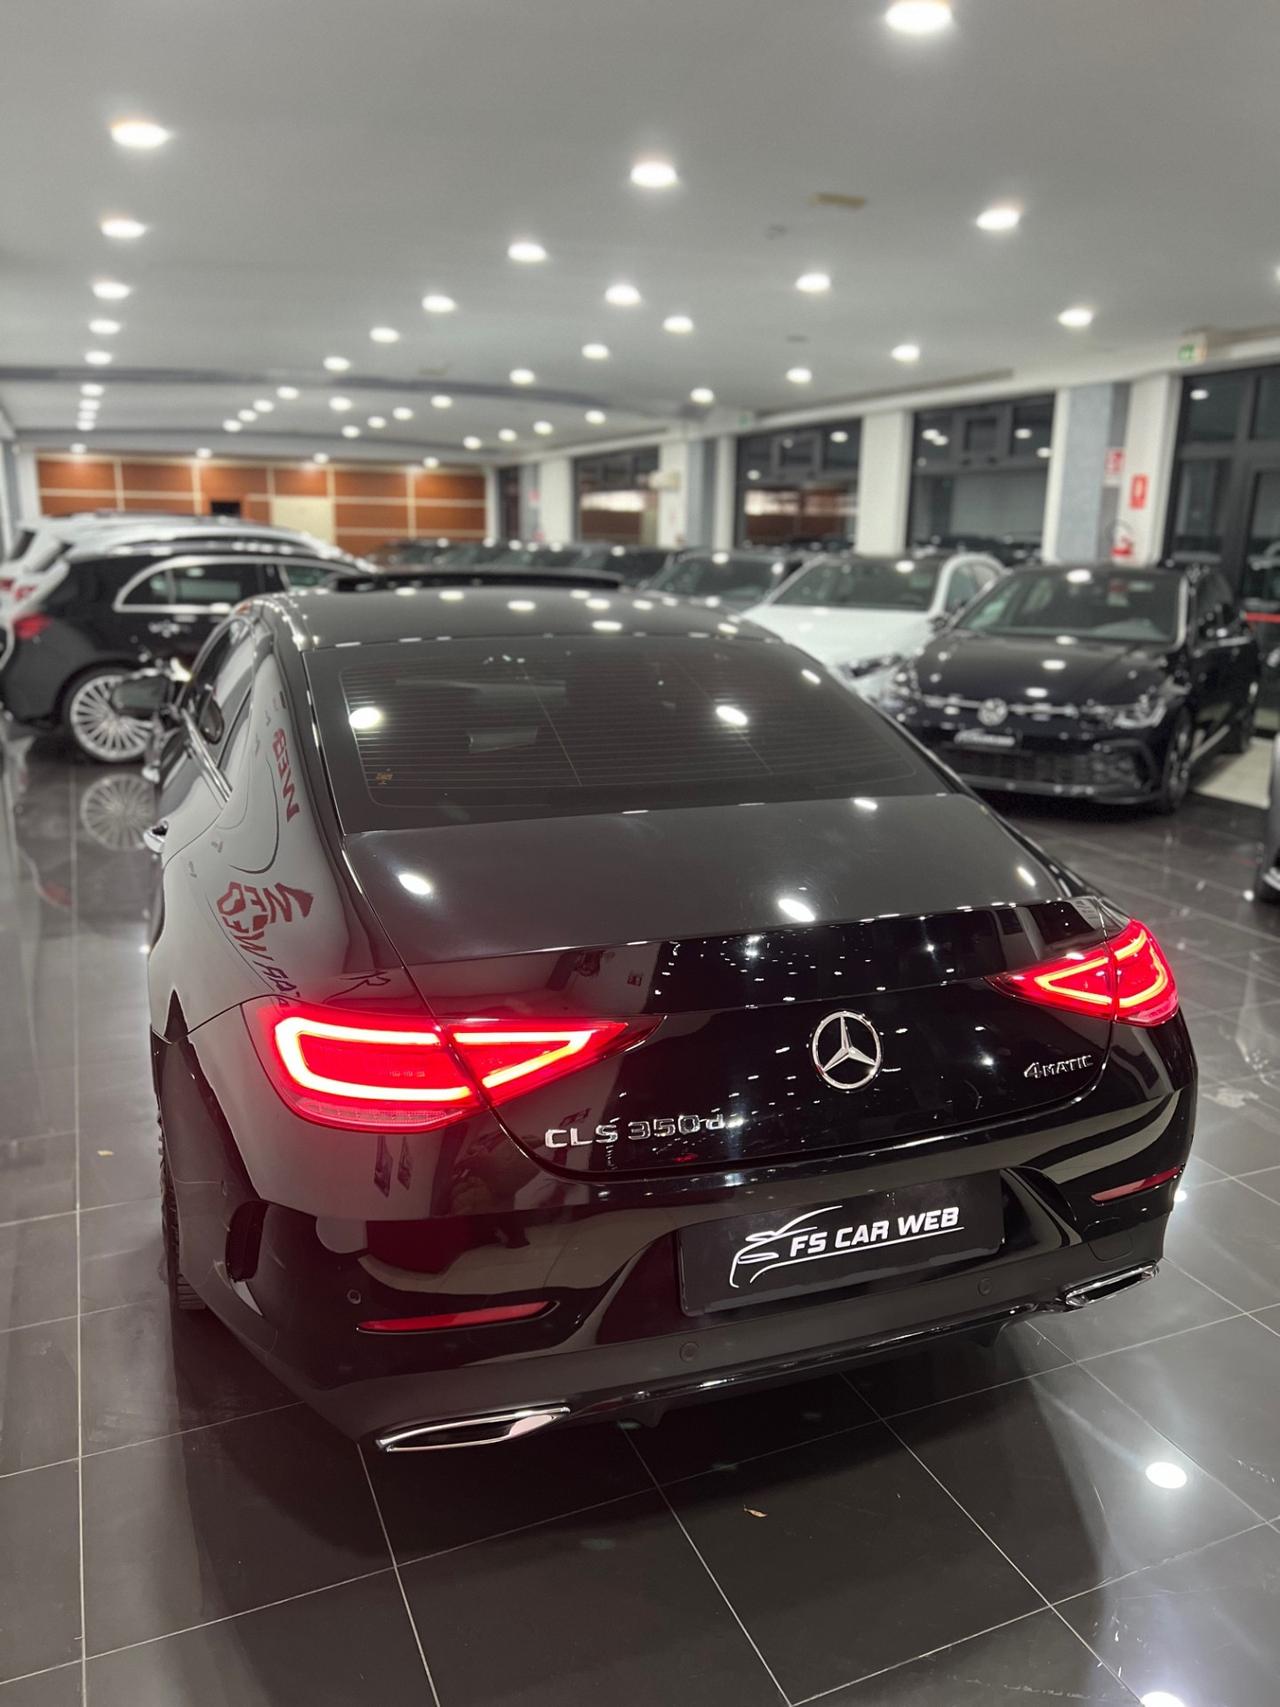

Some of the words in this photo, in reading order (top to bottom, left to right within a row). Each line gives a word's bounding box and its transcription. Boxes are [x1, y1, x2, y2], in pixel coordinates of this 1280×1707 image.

[1023, 1054, 1094, 1079] 4MATIC
[544, 1124, 619, 1149] CLS
[627, 1113, 726, 1141] 350d
[789, 1231, 828, 1258] FS
[834, 1219, 890, 1249] CAR
[896, 1206, 960, 1236] WEB
